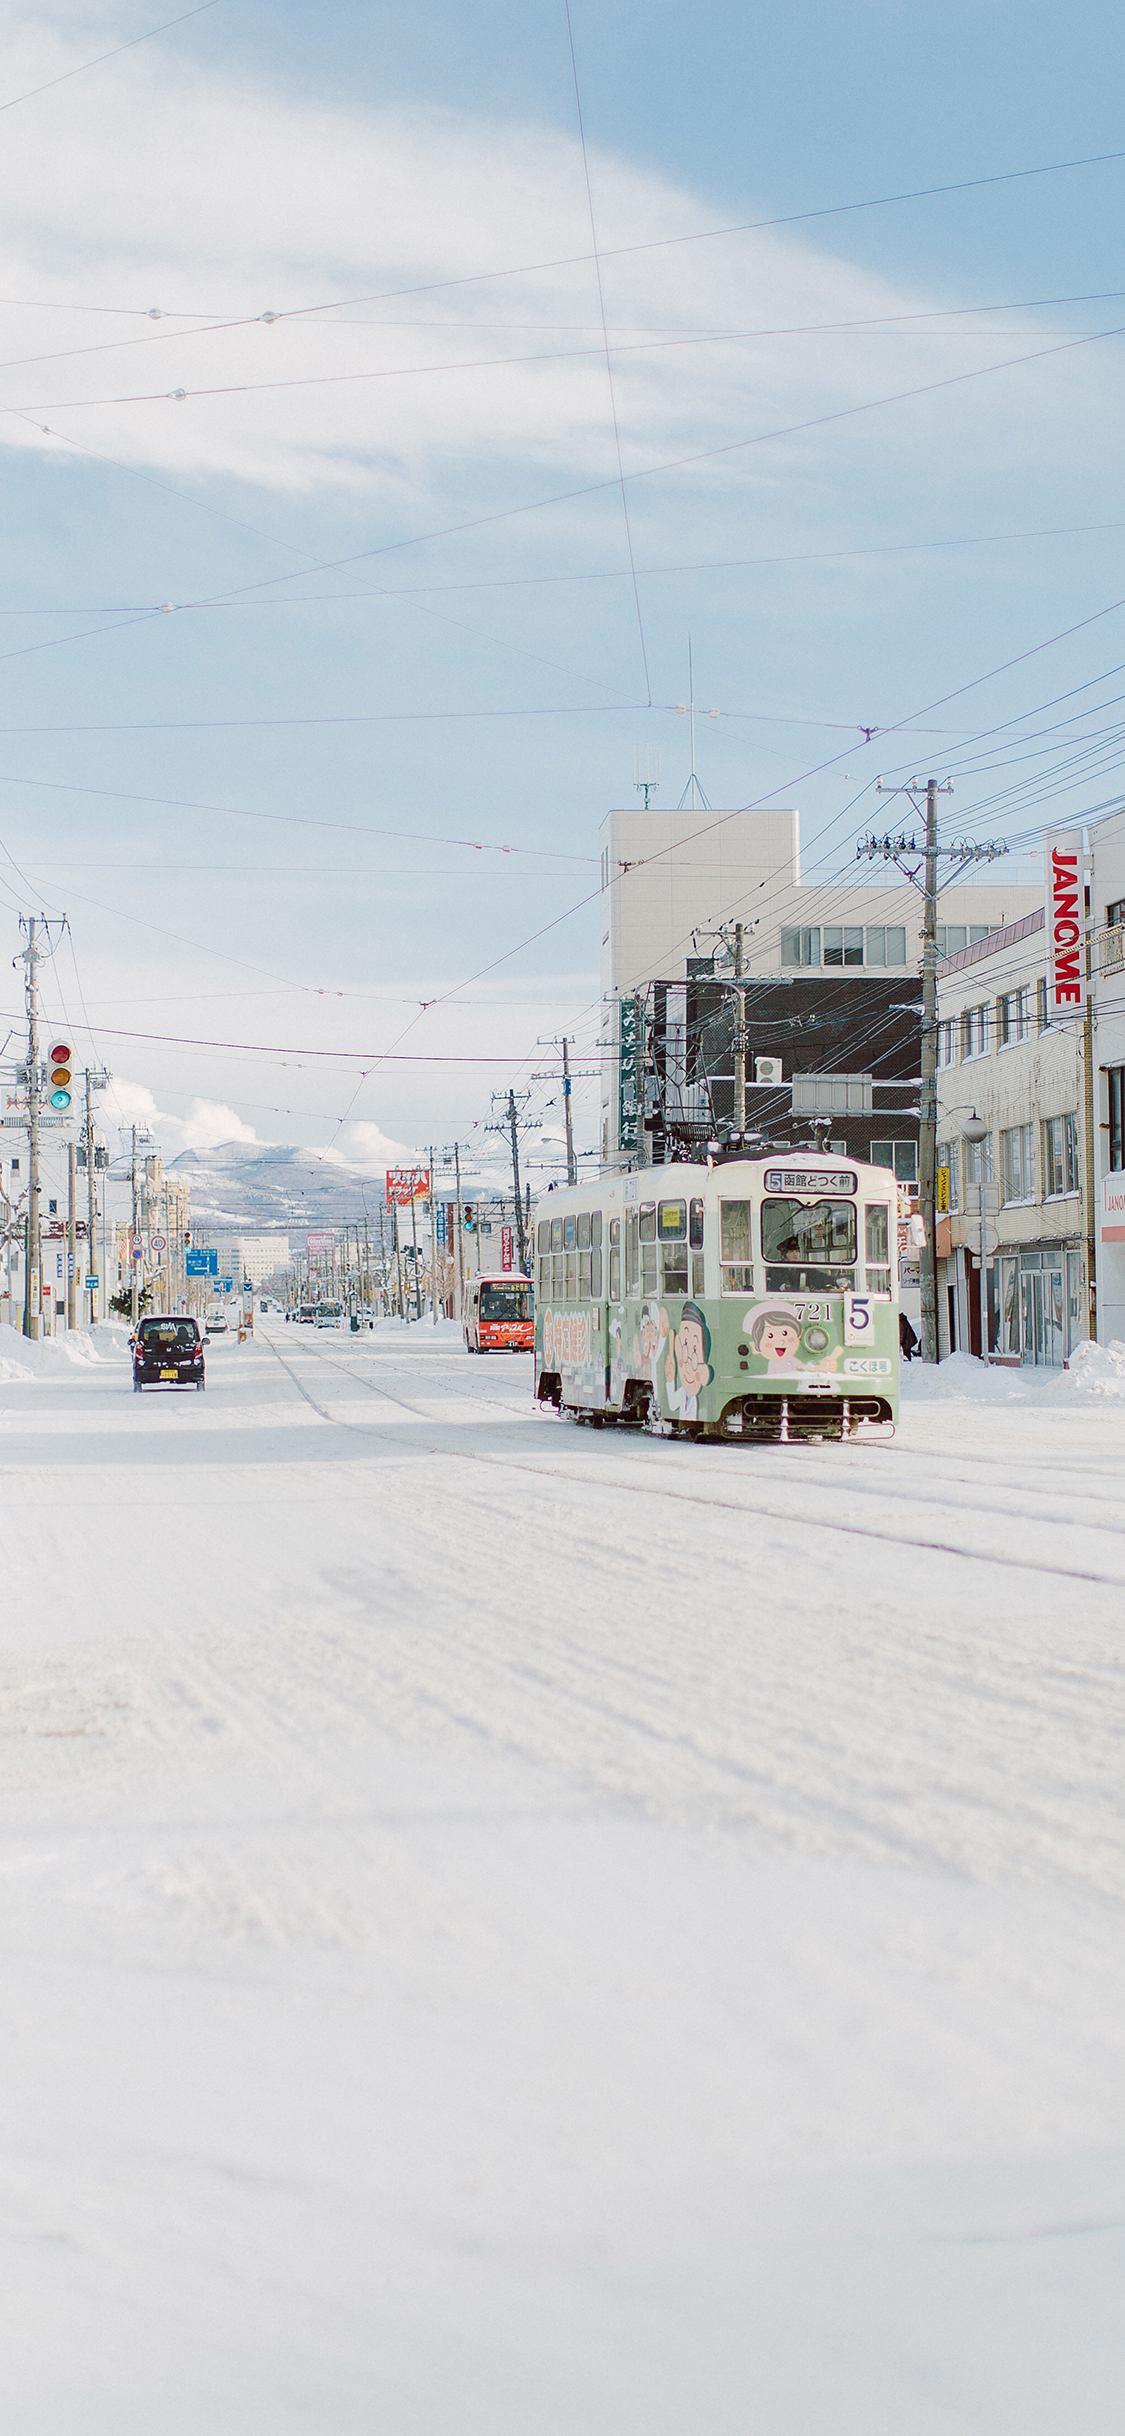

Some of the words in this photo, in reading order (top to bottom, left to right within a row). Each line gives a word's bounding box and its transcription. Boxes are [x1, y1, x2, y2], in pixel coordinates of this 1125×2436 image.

[1052, 846, 1081, 1004] JANOME
[388, 1171, 428, 1185] ツルハ
[769, 1174, 781, 1189] 5
[784, 1174, 851, 1188] 函館どつく前
[1108, 1194, 1125, 1212] JANO
[153, 1238, 163, 1248] 40
[794, 1303, 833, 1321] 721
[849, 1298, 870, 1330] 5
[850, 1361, 888, 1373] こくほ号
